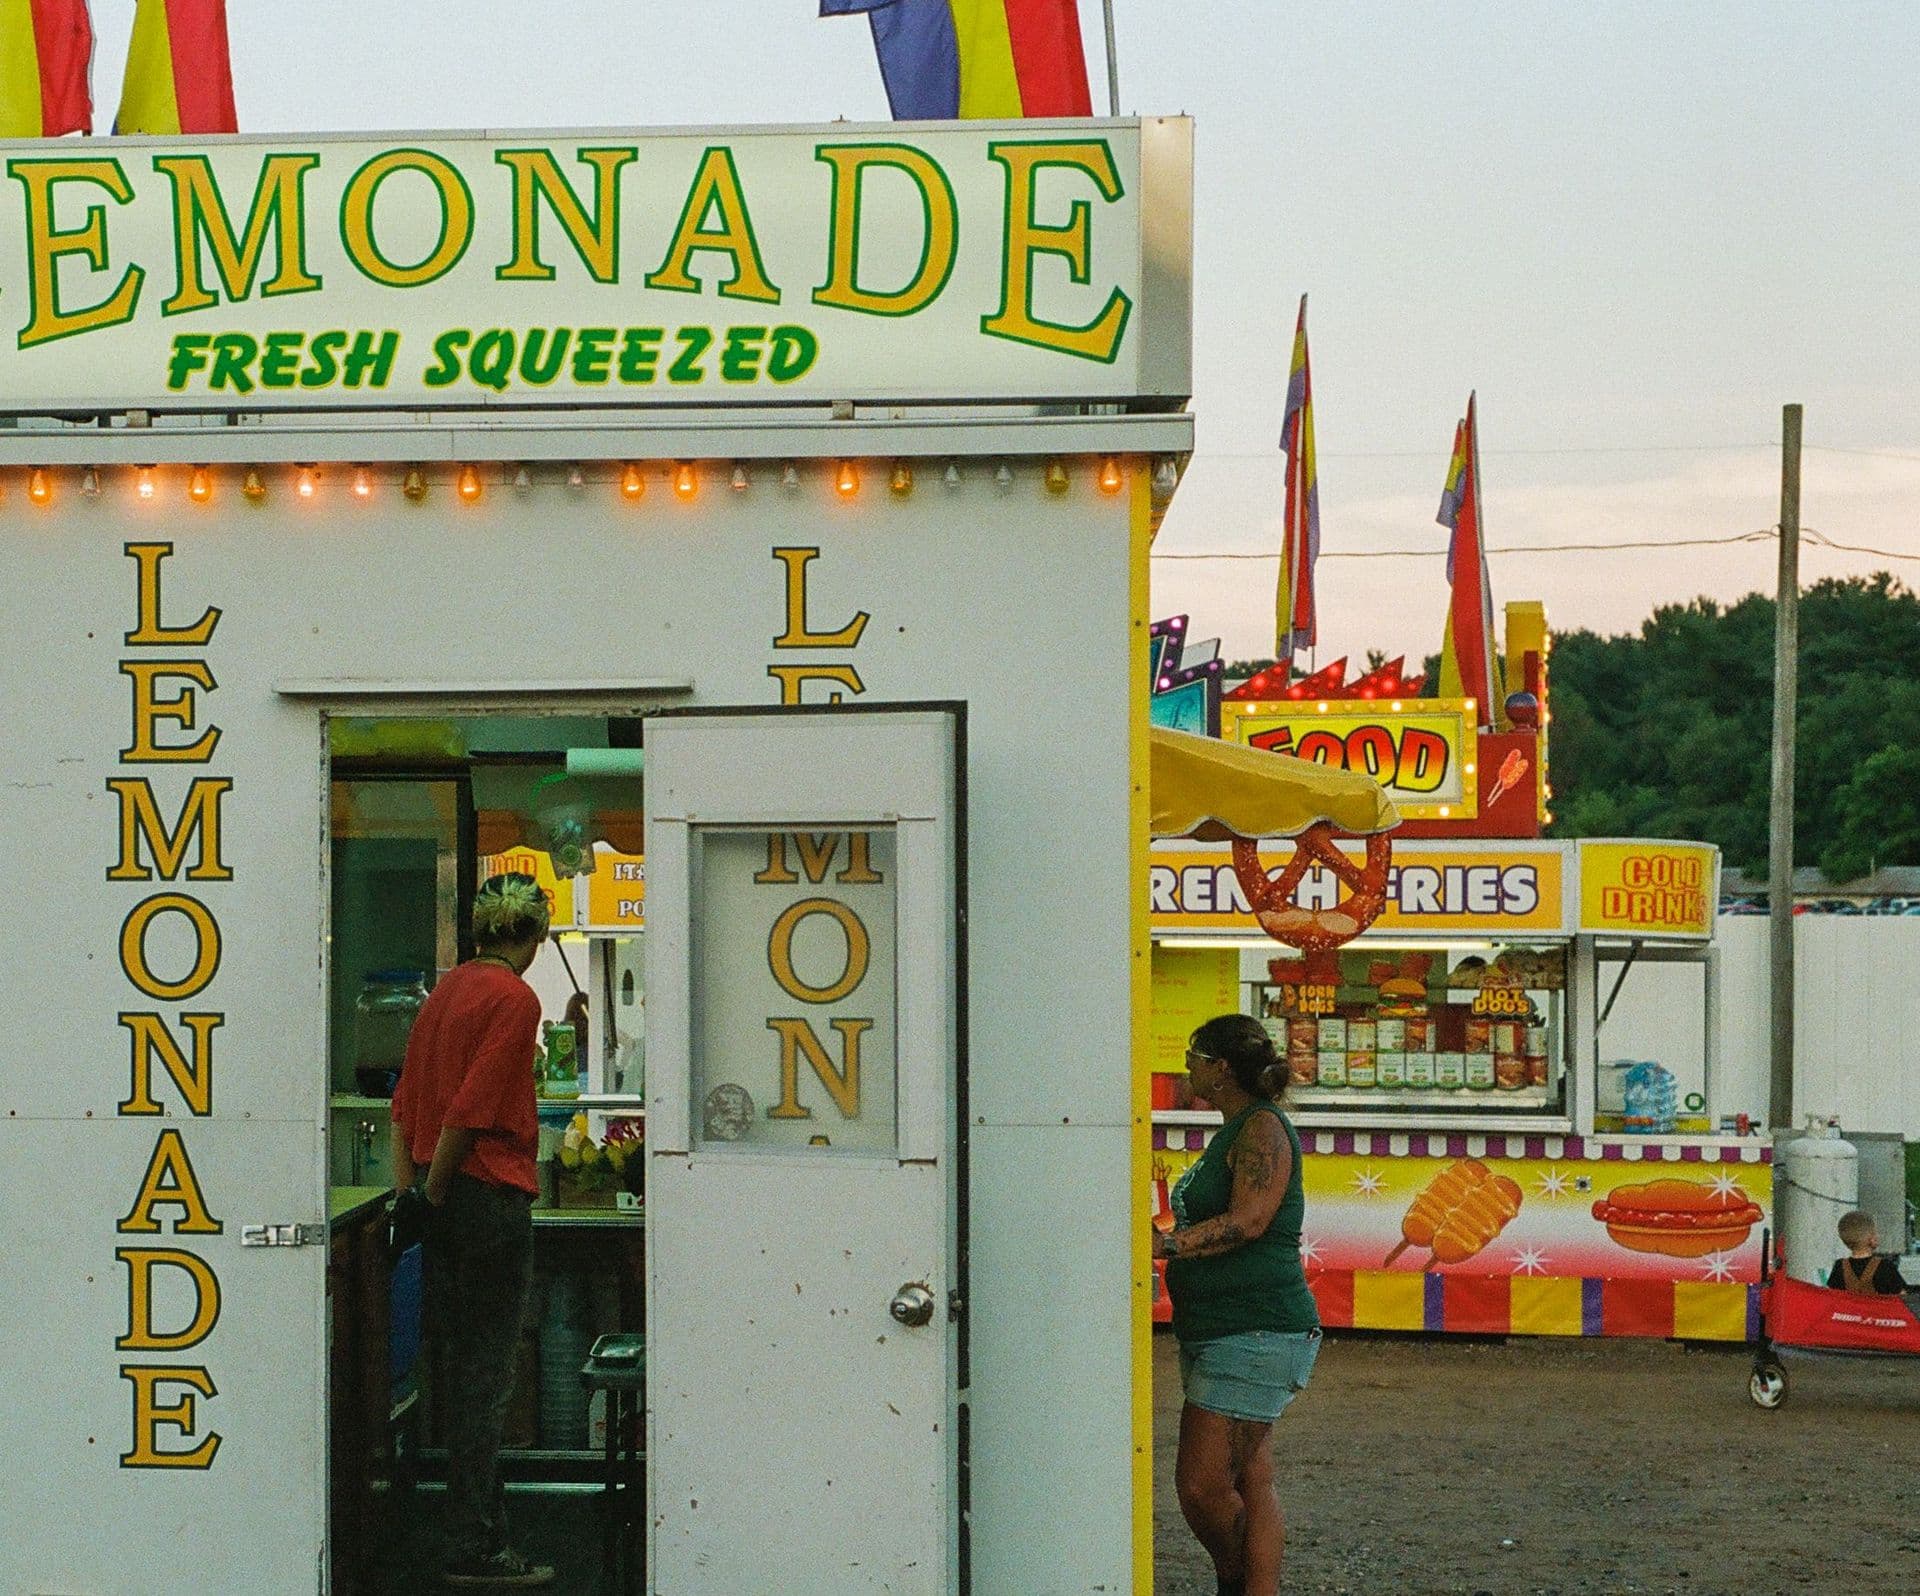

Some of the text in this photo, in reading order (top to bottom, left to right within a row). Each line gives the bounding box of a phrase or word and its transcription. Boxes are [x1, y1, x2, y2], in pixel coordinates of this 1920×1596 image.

[0, 139, 1133, 364] EMONADE
[165, 324, 820, 397] FRESH SQUEEZED
[1622, 855, 1701, 889] COLD
[1299, 984, 1336, 999] CORN
[1480, 986, 1524, 1003] HOT
[105, 541, 233, 1470] LEMONADE
[1299, 999, 1336, 1014] DOGS
[1472, 997, 1530, 1015] DOGS
